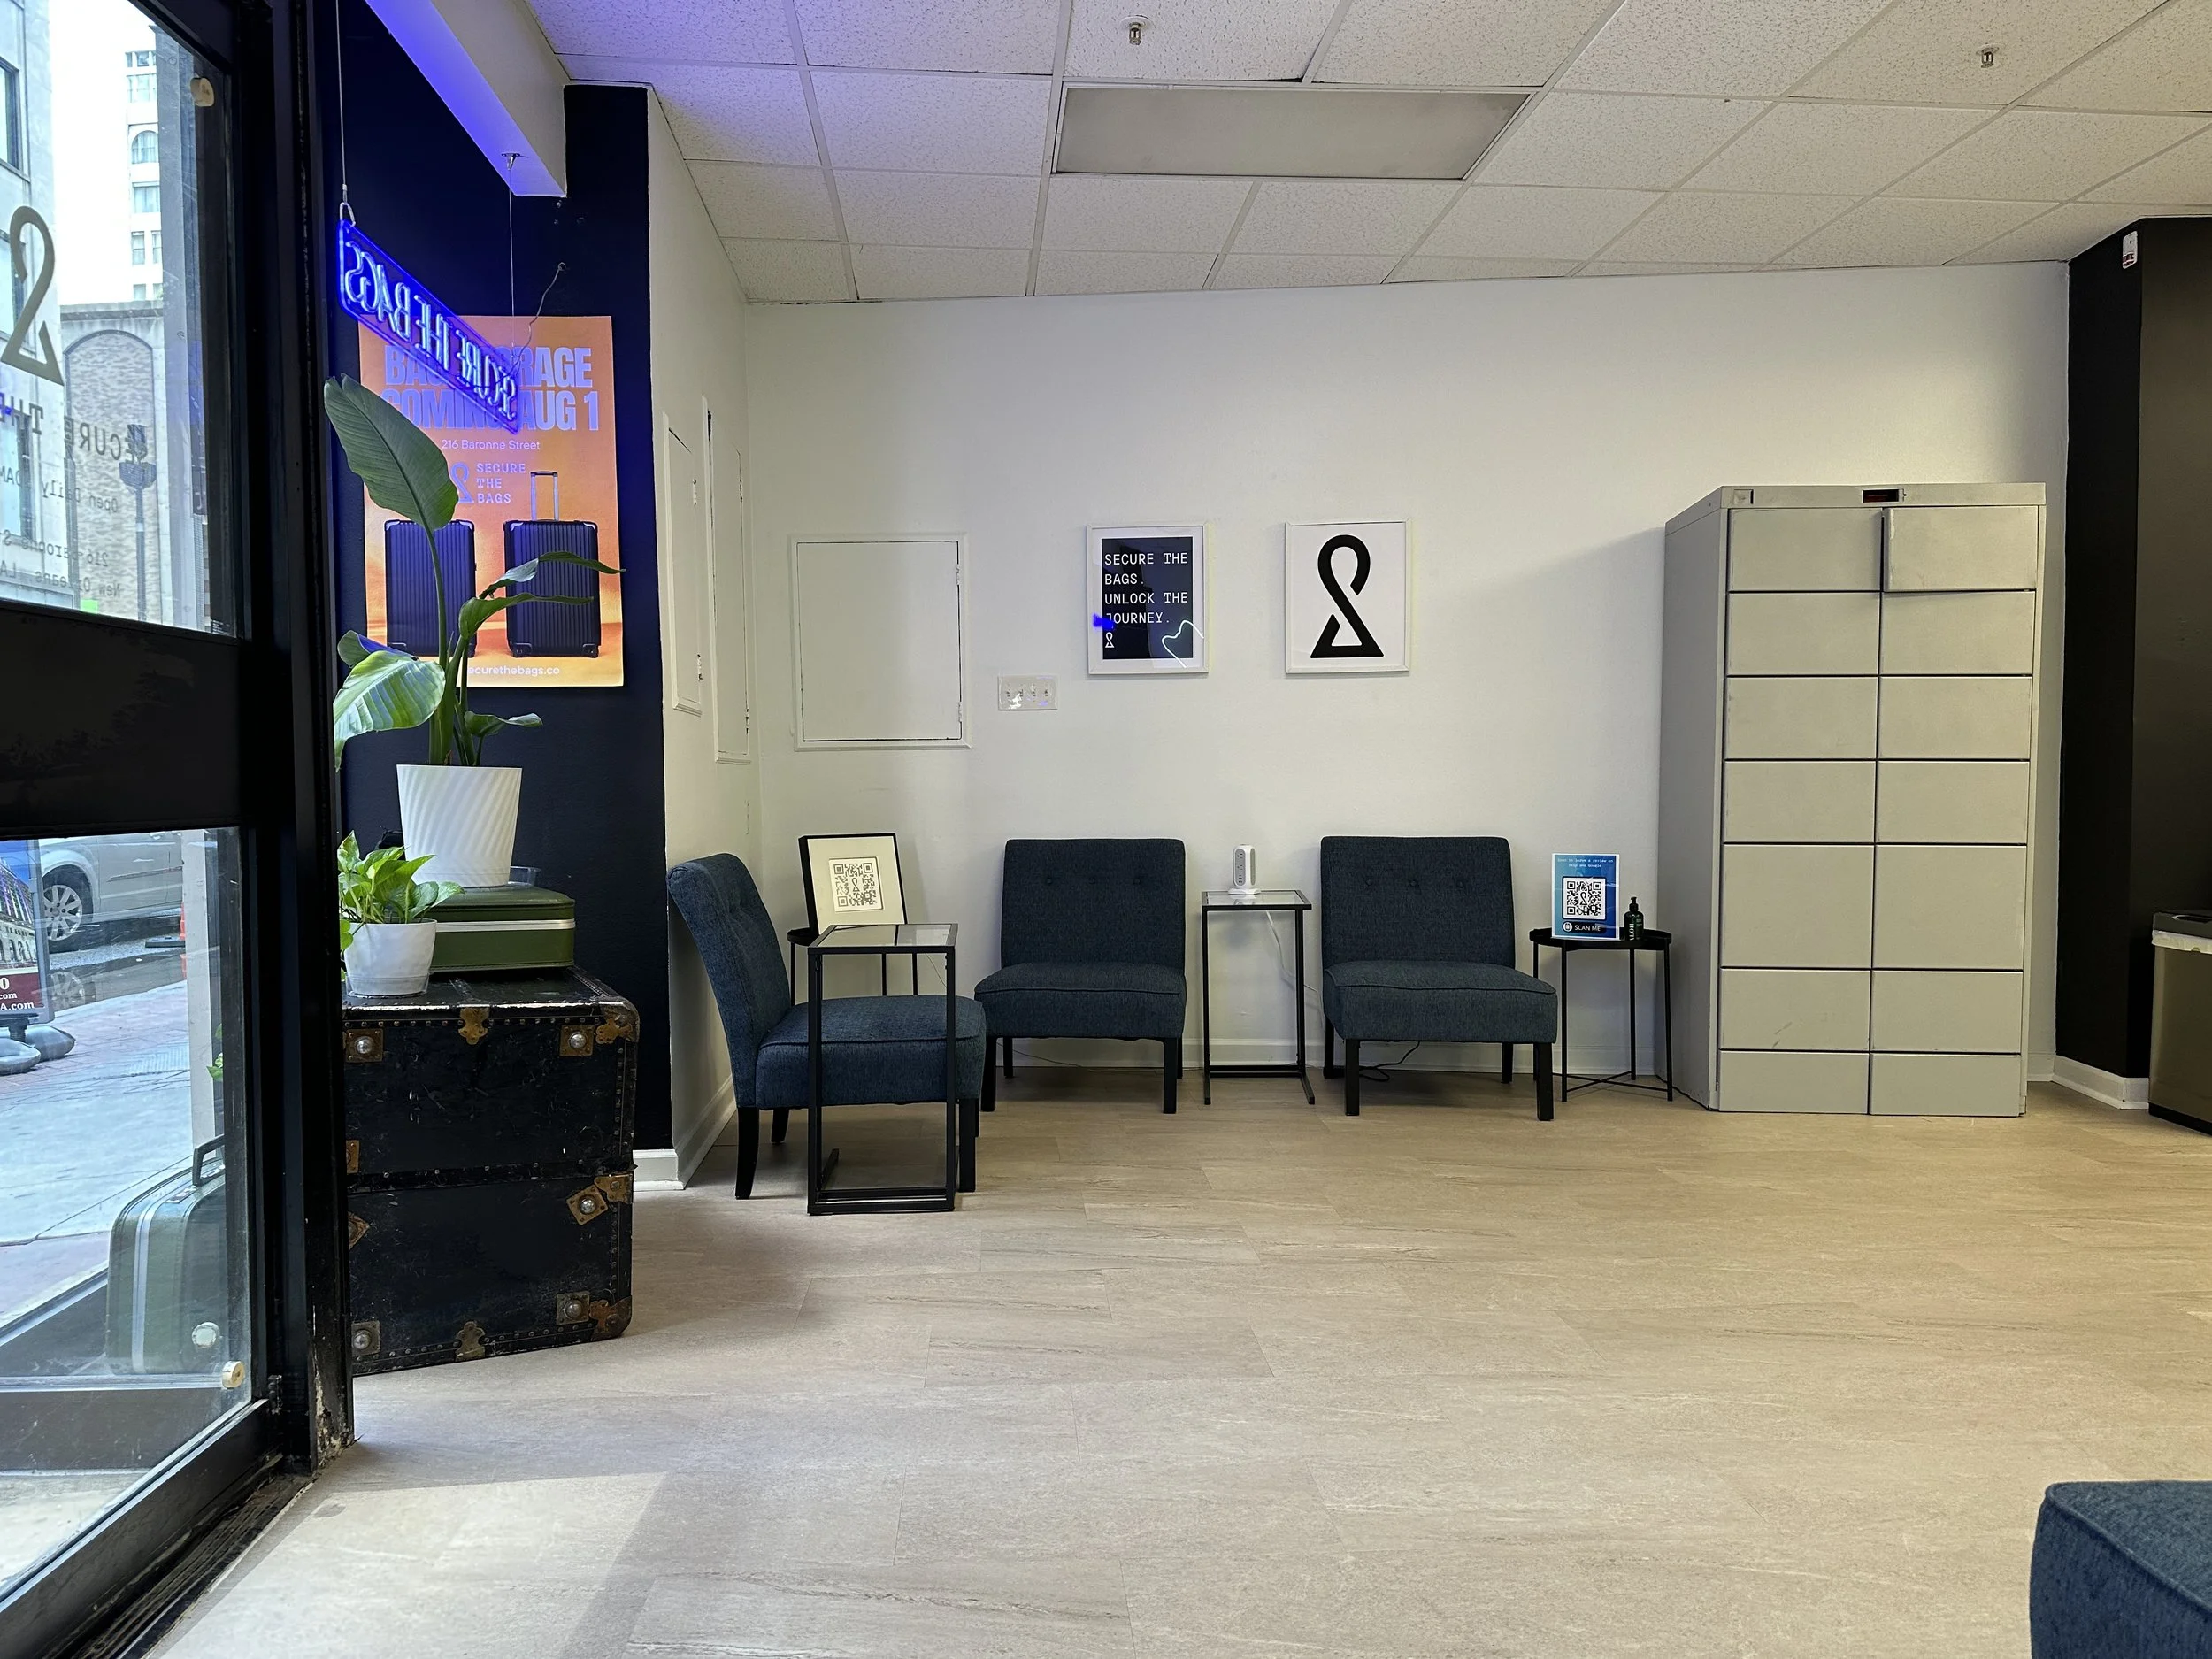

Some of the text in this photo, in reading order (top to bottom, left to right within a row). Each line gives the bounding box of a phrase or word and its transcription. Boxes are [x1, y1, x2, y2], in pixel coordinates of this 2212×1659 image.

[520, 389, 576, 432] AUG
[583, 390, 599, 431] 1
[442, 439, 541, 450] 216 Baronne Street
[476, 463, 526, 473] SECURE
[477, 478, 502, 488] THE
[478, 493, 511, 503] BAGS
[1104, 552, 1187, 565] SECURE THE
[1104, 573, 1144, 585] BAGS.
[1104, 592, 1187, 604] UNLOCK THE
[467, 665, 560, 677] ecurethebags.co
